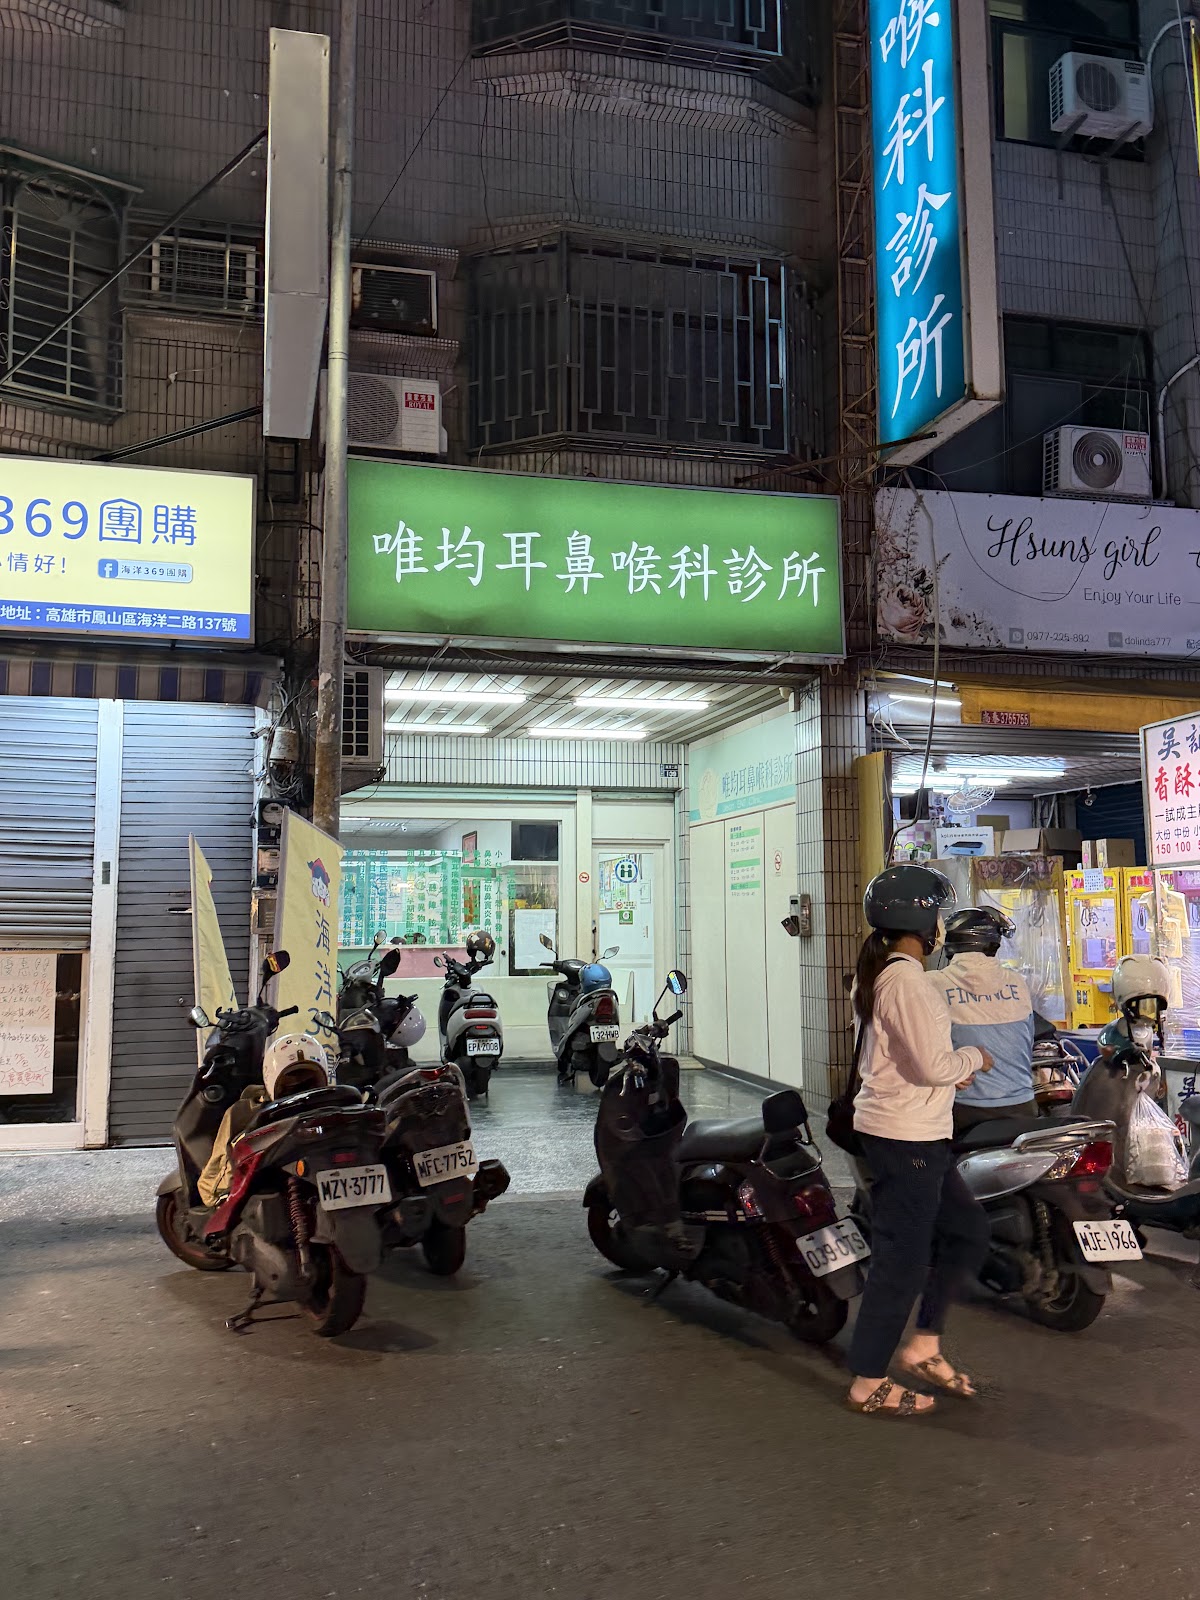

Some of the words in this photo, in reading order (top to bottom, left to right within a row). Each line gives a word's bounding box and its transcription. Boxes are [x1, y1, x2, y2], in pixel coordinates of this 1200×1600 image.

[0, 551, 66, 574] 情好!
[987, 515, 1096, 566] Hsuns
[1103, 526, 1162, 580] girl
[372, 520, 826, 607] 唯均耳鼻喉科診所
[1084, 588, 1121, 605] Enjoy
[1126, 591, 1153, 605] Your
[1158, 591, 1181, 605] Life
[722, 753, 793, 798] 唯均耳鼻喉科診所
[1155, 762, 1200, 802] 香酥
[1155, 804, 1200, 822] 一試成主
[1156, 843, 1171, 854] 150
[1175, 841, 1191, 853] 100
